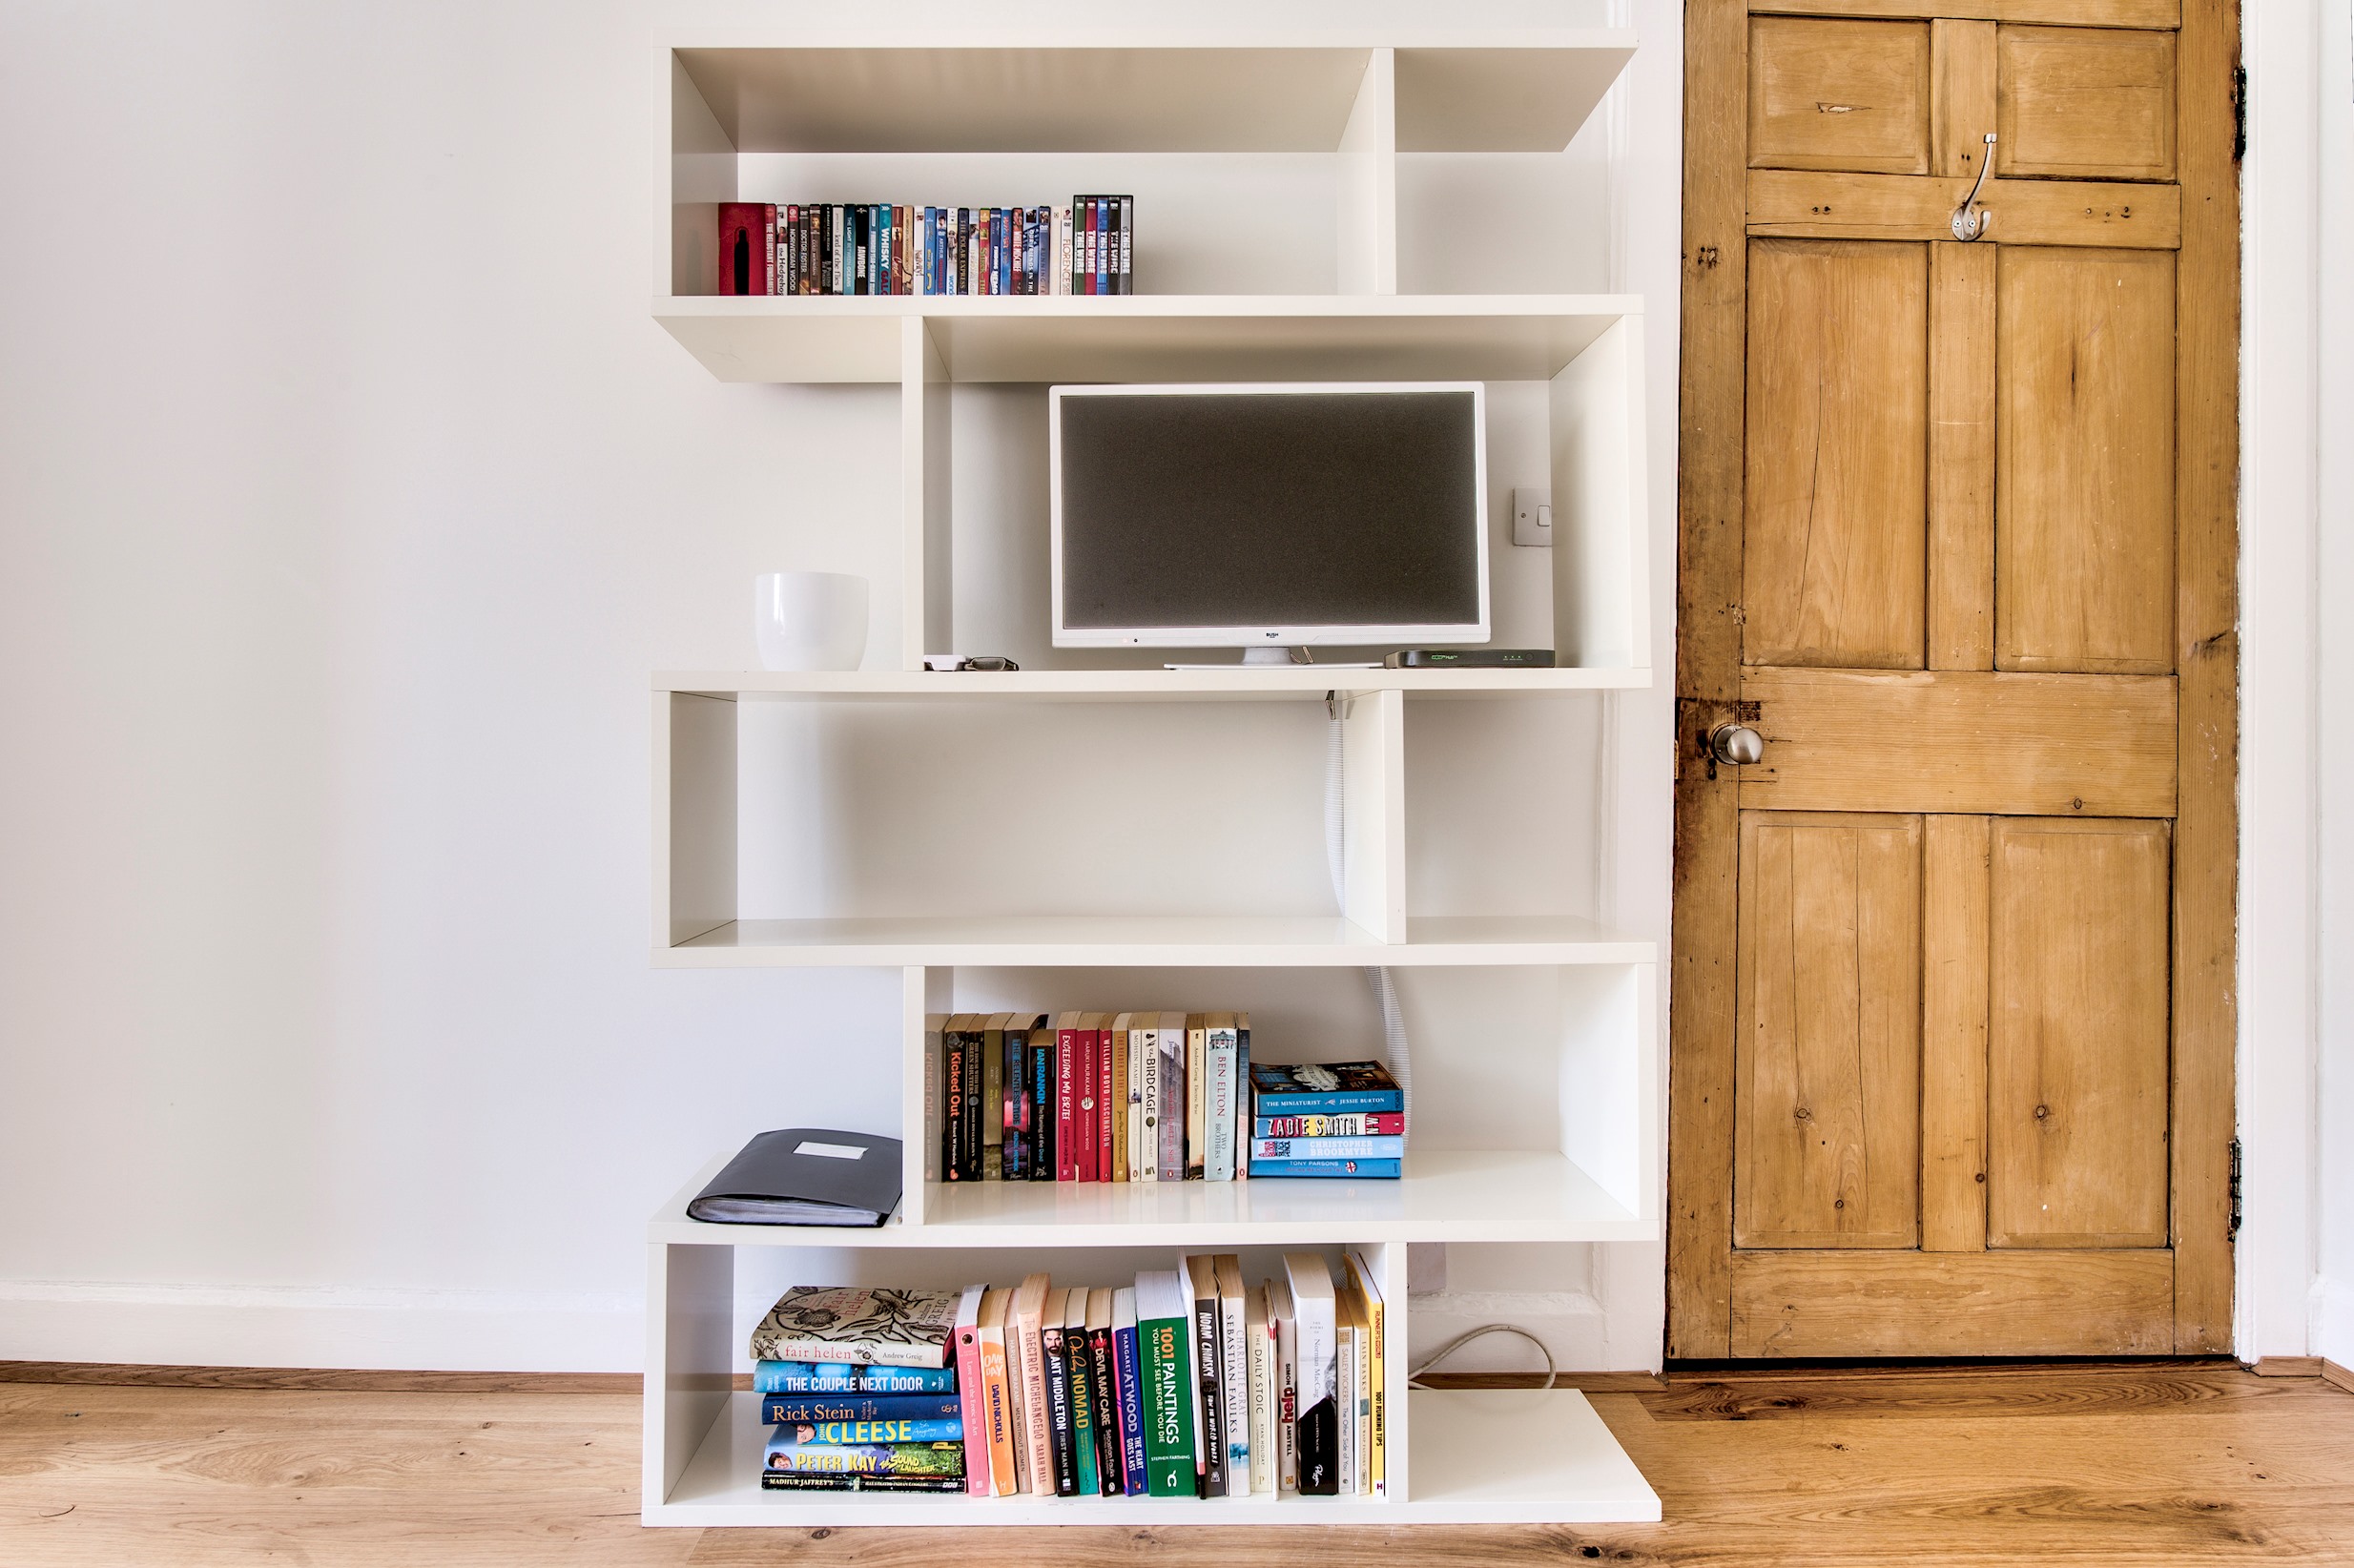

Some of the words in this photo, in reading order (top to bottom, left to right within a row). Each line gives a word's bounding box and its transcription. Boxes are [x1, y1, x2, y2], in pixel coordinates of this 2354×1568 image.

[1013, 248, 1022, 272] MISCHIEF
[1037, 1048, 1045, 1065] IAN
[1062, 1035, 1071, 1079] EXCEEDING
[1217, 1057, 1226, 1077] BEN
[950, 1052, 961, 1092] Kicked
[1037, 1066, 1045, 1104] RANKIN
[1062, 1082, 1070, 1093] MY
[1217, 1082, 1226, 1116] ELTON
[950, 1095, 960, 1117] Out
[1062, 1096, 1070, 1122] BRIEF
[1268, 1118, 1310, 1136] ZADIE
[1315, 1118, 1357, 1135] SMITH
[785, 1345, 810, 1358] fair
[814, 1347, 851, 1359] helen
[1122, 1333, 1132, 1373] MARGARET
[1161, 1327, 1175, 1359] 1001
[1227, 1314, 1236, 1381] SEBASTIAN
[983, 1353, 1003, 1368] ONE
[985, 1364, 1003, 1377] DAY
[1050, 1356, 1062, 1376] ANT
[1095, 1348, 1105, 1376] DEVIL
[1236, 1330, 1247, 1385] CHARLOTTE
[1254, 1349, 1264, 1380] DAILY
[786, 1377, 808, 1391] THE
[811, 1377, 857, 1392] COUPLE
[859, 1377, 888, 1392] NEXT
[889, 1377, 923, 1391] DOOR
[992, 1384, 1001, 1407] DAVID
[1011, 1365, 1020, 1404] MURAKAMI
[1097, 1377, 1108, 1397] MAY
[1312, 1369, 1322, 1397] MacCaig
[1052, 1377, 1066, 1431] MIDDLETON
[1072, 1374, 1089, 1429] NOMAD
[1124, 1373, 1138, 1433] ATWOOD
[1163, 1362, 1179, 1445] PAINTINGS
[1229, 1388, 1238, 1434] FAULKS
[1238, 1389, 1247, 1415] GRAY
[1255, 1382, 1264, 1414] STOIC
[772, 1406, 810, 1421] Rick
[814, 1404, 855, 1420] Stein
[994, 1407, 1003, 1443] NICHOLLS
[1100, 1399, 1111, 1426] CARE
[818, 1424, 827, 1441] JOHN
[826, 1420, 912, 1443] CLEESE
[795, 1453, 842, 1471] PETER
[848, 1455, 878, 1471] KAY
[1135, 1449, 1144, 1470] HEART
